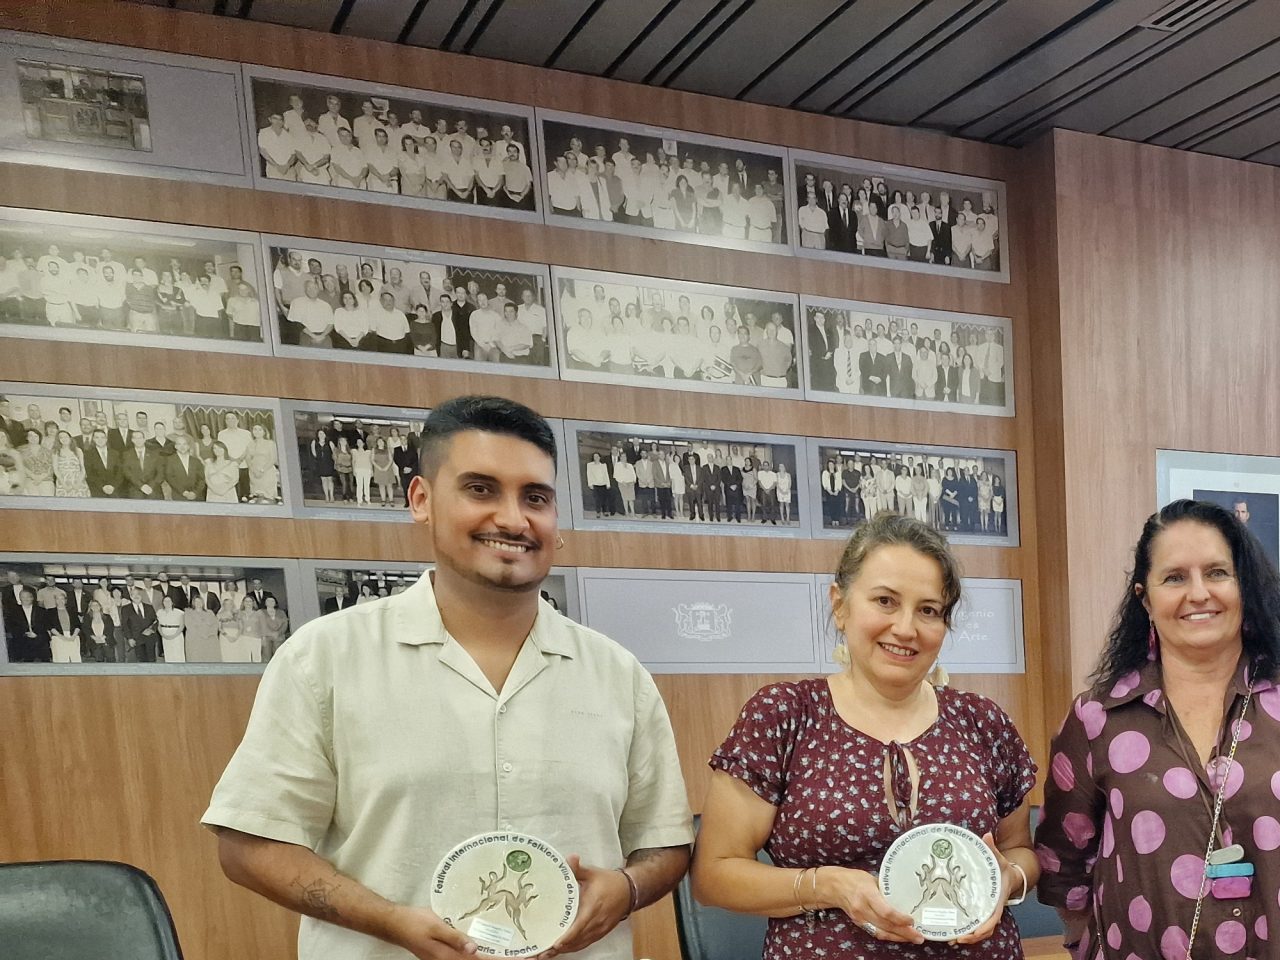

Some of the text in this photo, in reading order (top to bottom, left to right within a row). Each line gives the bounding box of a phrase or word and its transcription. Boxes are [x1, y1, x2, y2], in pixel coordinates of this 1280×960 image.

[886, 828, 929, 865] Internacional
[944, 827, 974, 841] Folklore
[986, 856, 994, 867] de
[434, 834, 575, 928] Festival Internacional de Folklore Villa de Ingenio
[883, 865, 891, 896] Festival
[990, 868, 998, 899] Ingenio
[916, 925, 948, 937] Canaria
[953, 918, 980, 936] España
[504, 944, 539, 957] España
